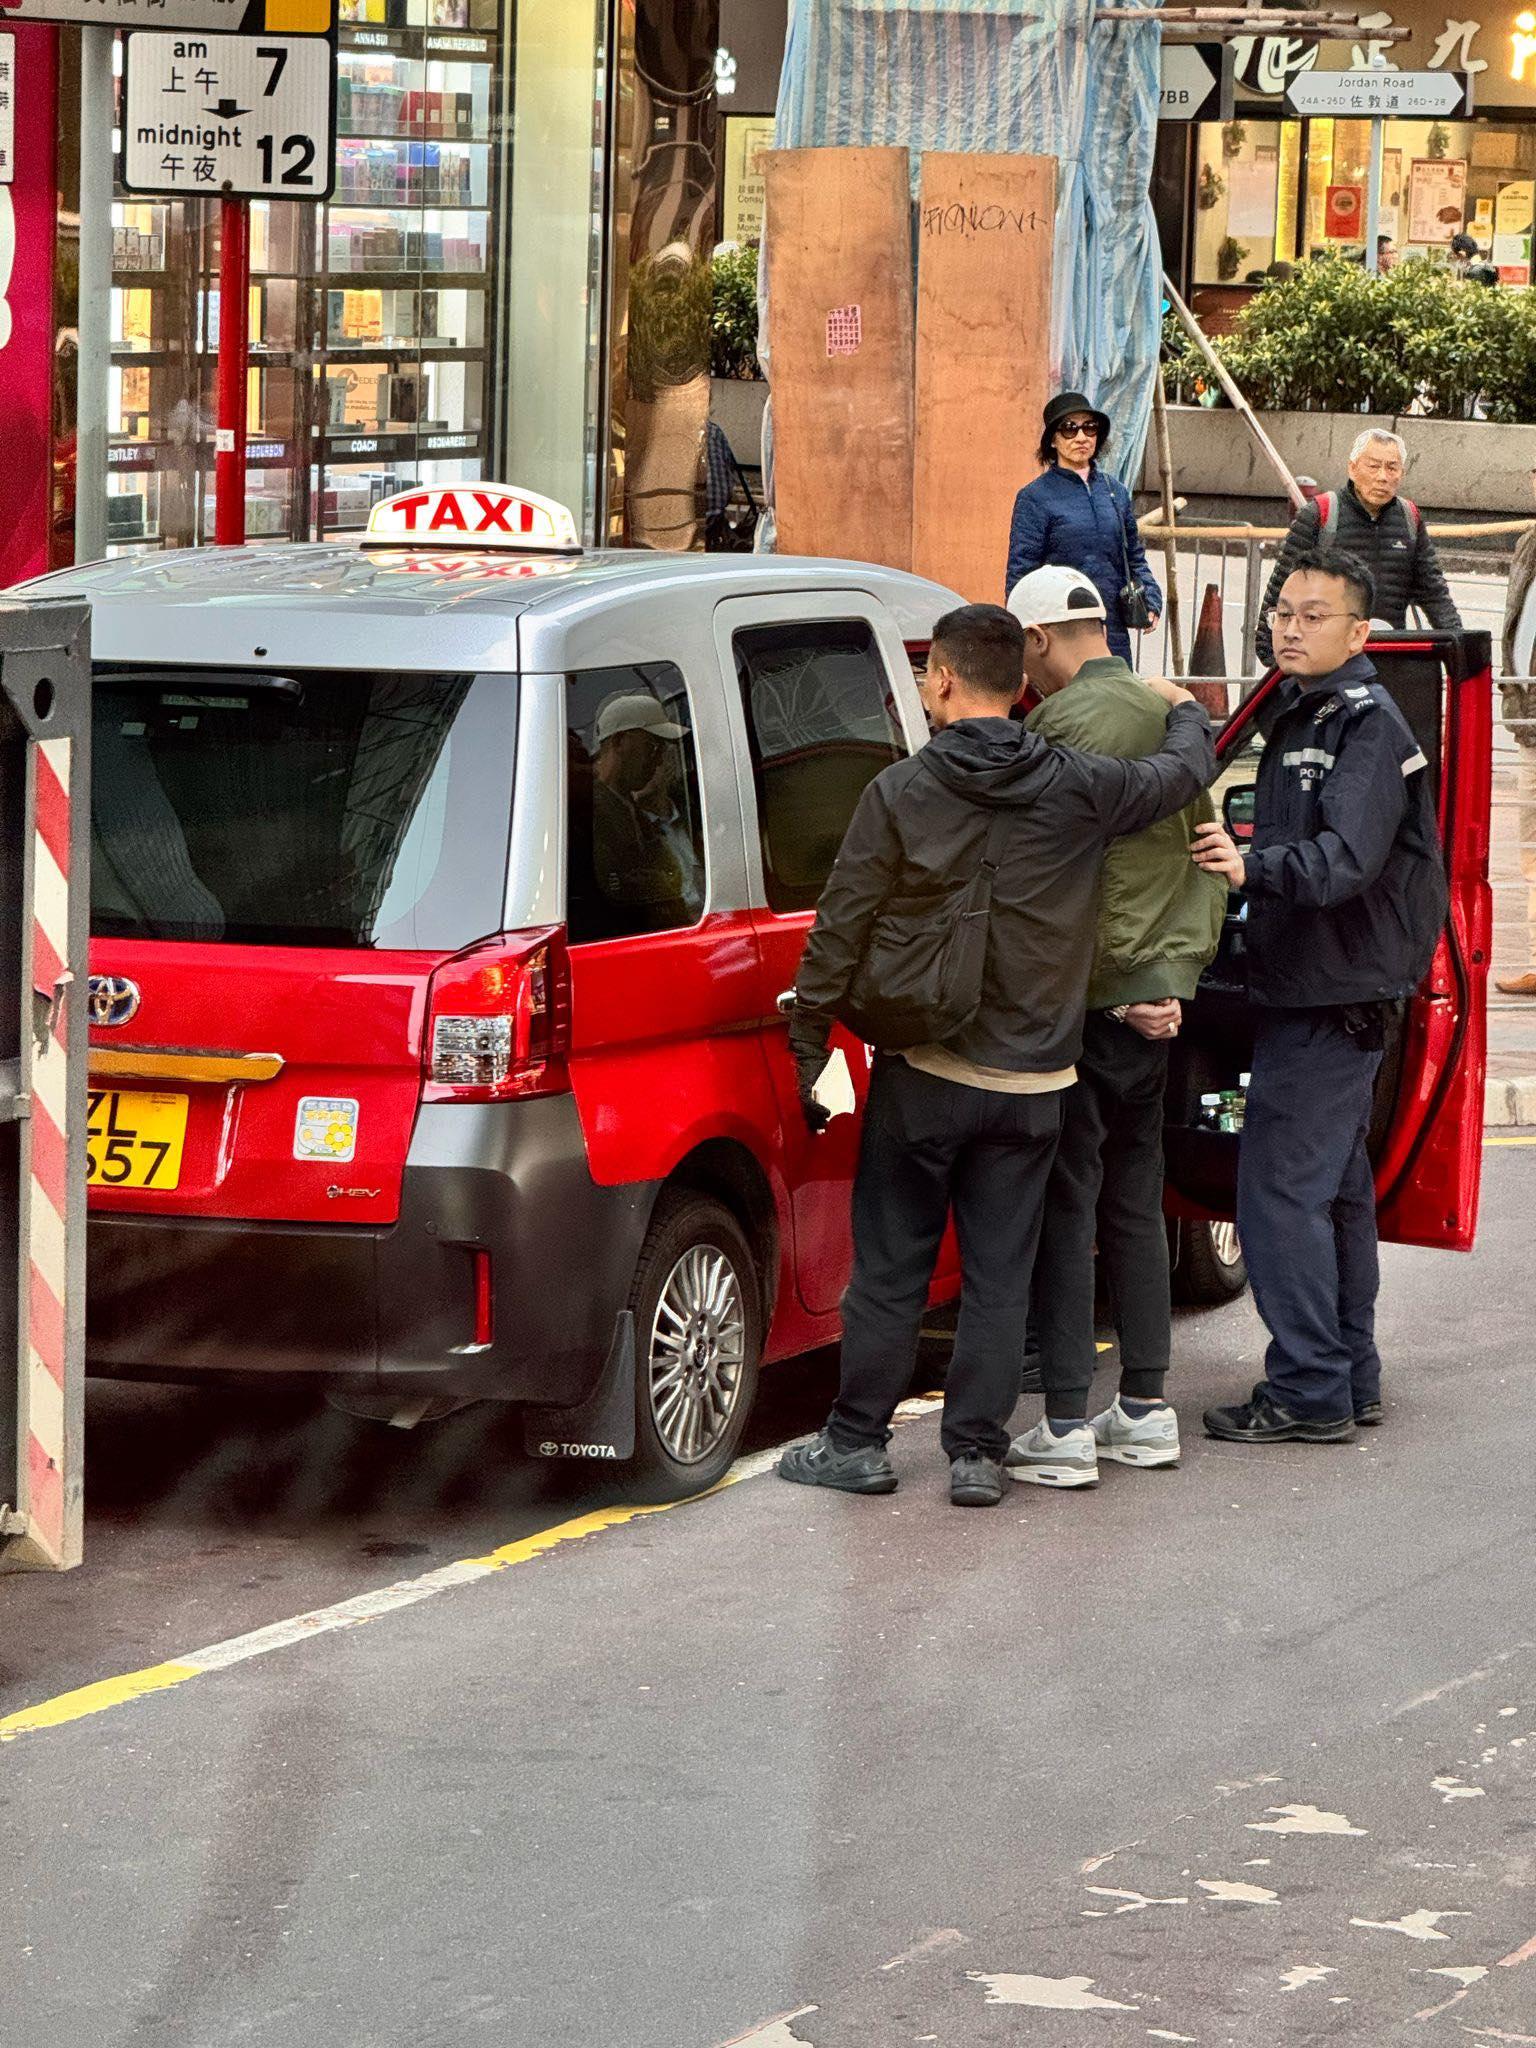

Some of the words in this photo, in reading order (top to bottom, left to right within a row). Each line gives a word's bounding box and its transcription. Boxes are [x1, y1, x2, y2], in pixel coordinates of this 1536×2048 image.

[173, 41, 208, 58] am
[162, 66, 219, 95] 上午
[256, 47, 288, 97] 7
[1338, 77, 1378, 88] Jordan
[1383, 77, 1414, 88] Road
[1351, 95, 1399, 109] 佐敦道
[137, 124, 242, 150] midnight
[161, 154, 217, 183] 午夜
[256, 135, 315, 186] 12
[107, 448, 138, 461] ENTLEY
[351, 440, 378, 452] COACH
[392, 493, 534, 532] TAXI
[561, 1443, 617, 1458] TOYOTA
